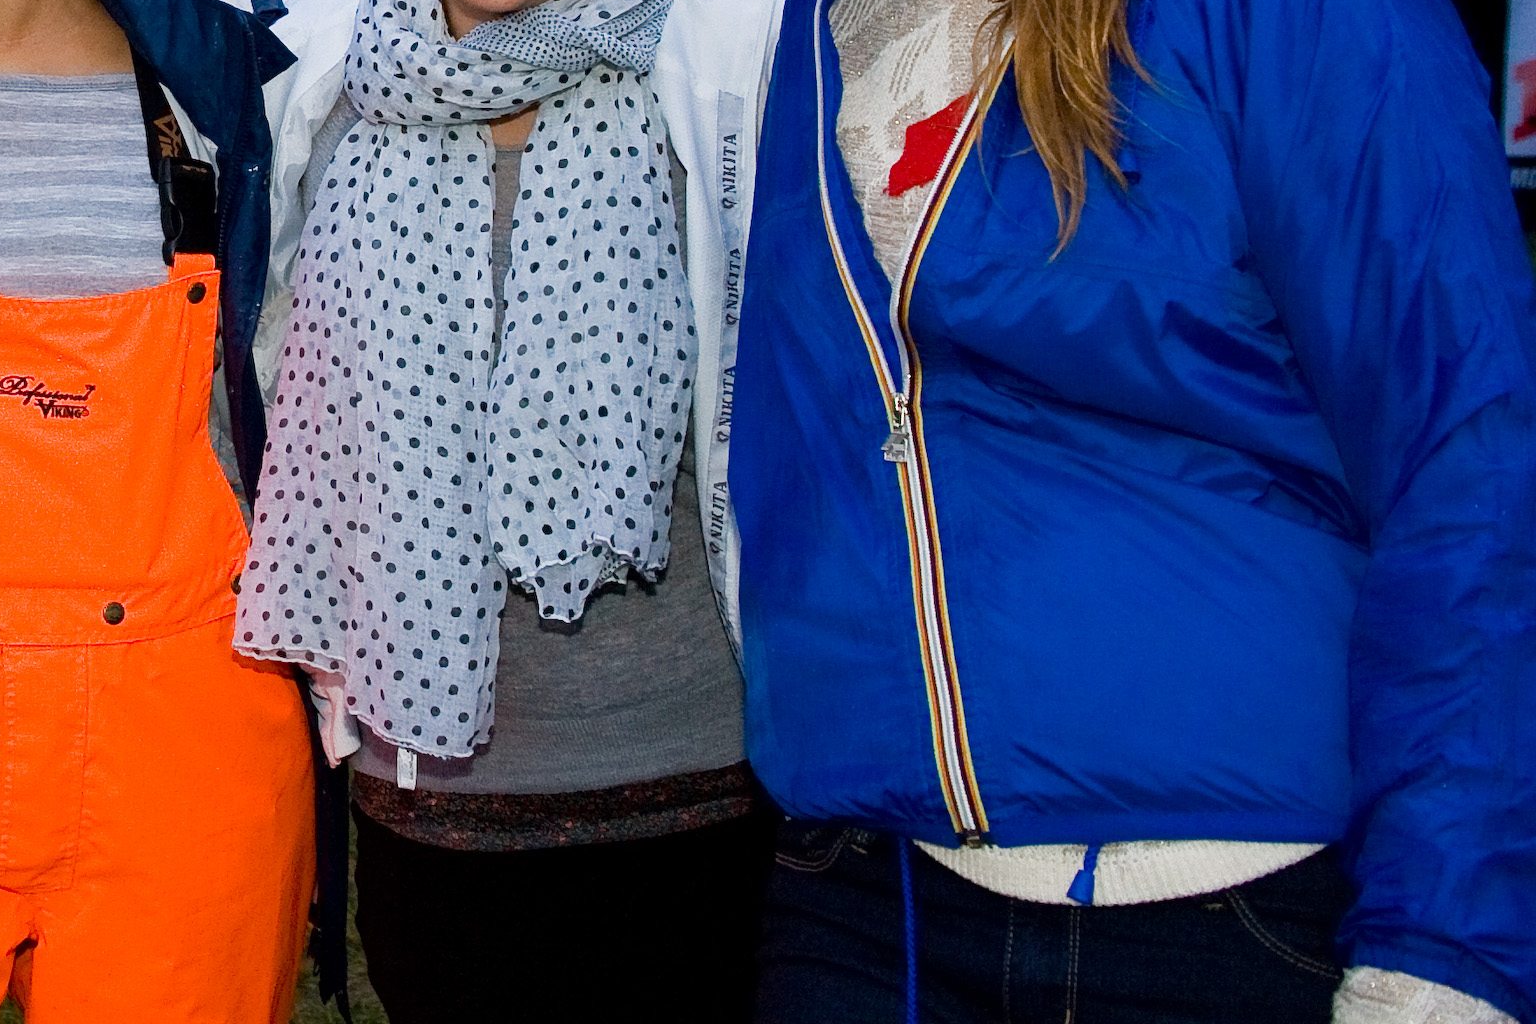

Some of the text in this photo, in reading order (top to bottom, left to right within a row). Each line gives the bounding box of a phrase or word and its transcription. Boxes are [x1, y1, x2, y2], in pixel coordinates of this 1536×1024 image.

[722, 133, 737, 194] NIKITA
[726, 247, 741, 310] NIKITA
[711, 480, 728, 545] NIKITA
